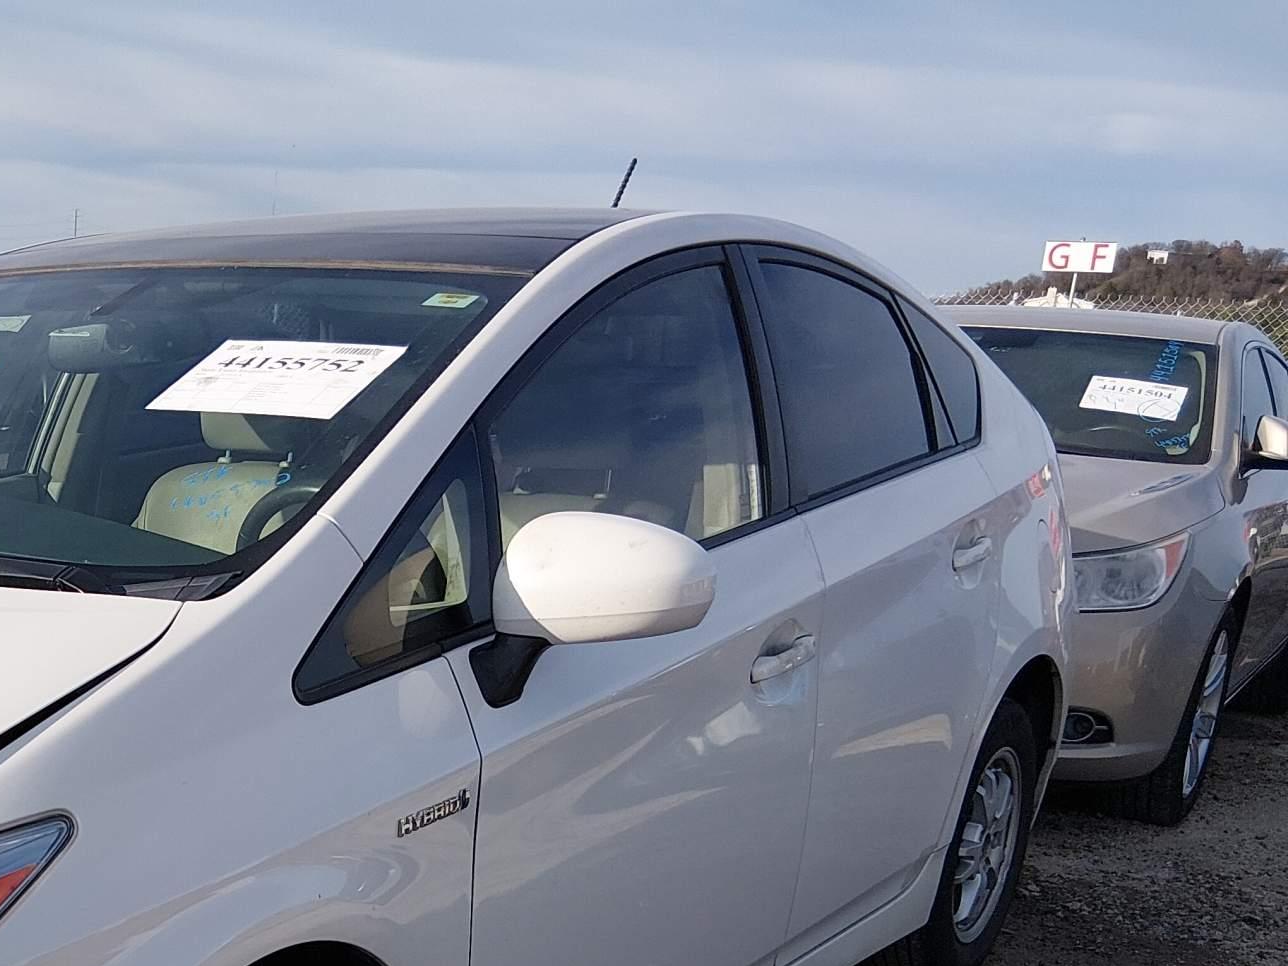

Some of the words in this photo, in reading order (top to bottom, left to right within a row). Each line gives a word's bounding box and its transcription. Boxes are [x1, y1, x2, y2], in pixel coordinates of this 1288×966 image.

[1048, 243, 1071, 269] G
[1090, 243, 1109, 270] F
[218, 355, 366, 374] 44155752
[1098, 384, 1173, 400] 44151504
[397, 796, 462, 838] HYBRID
